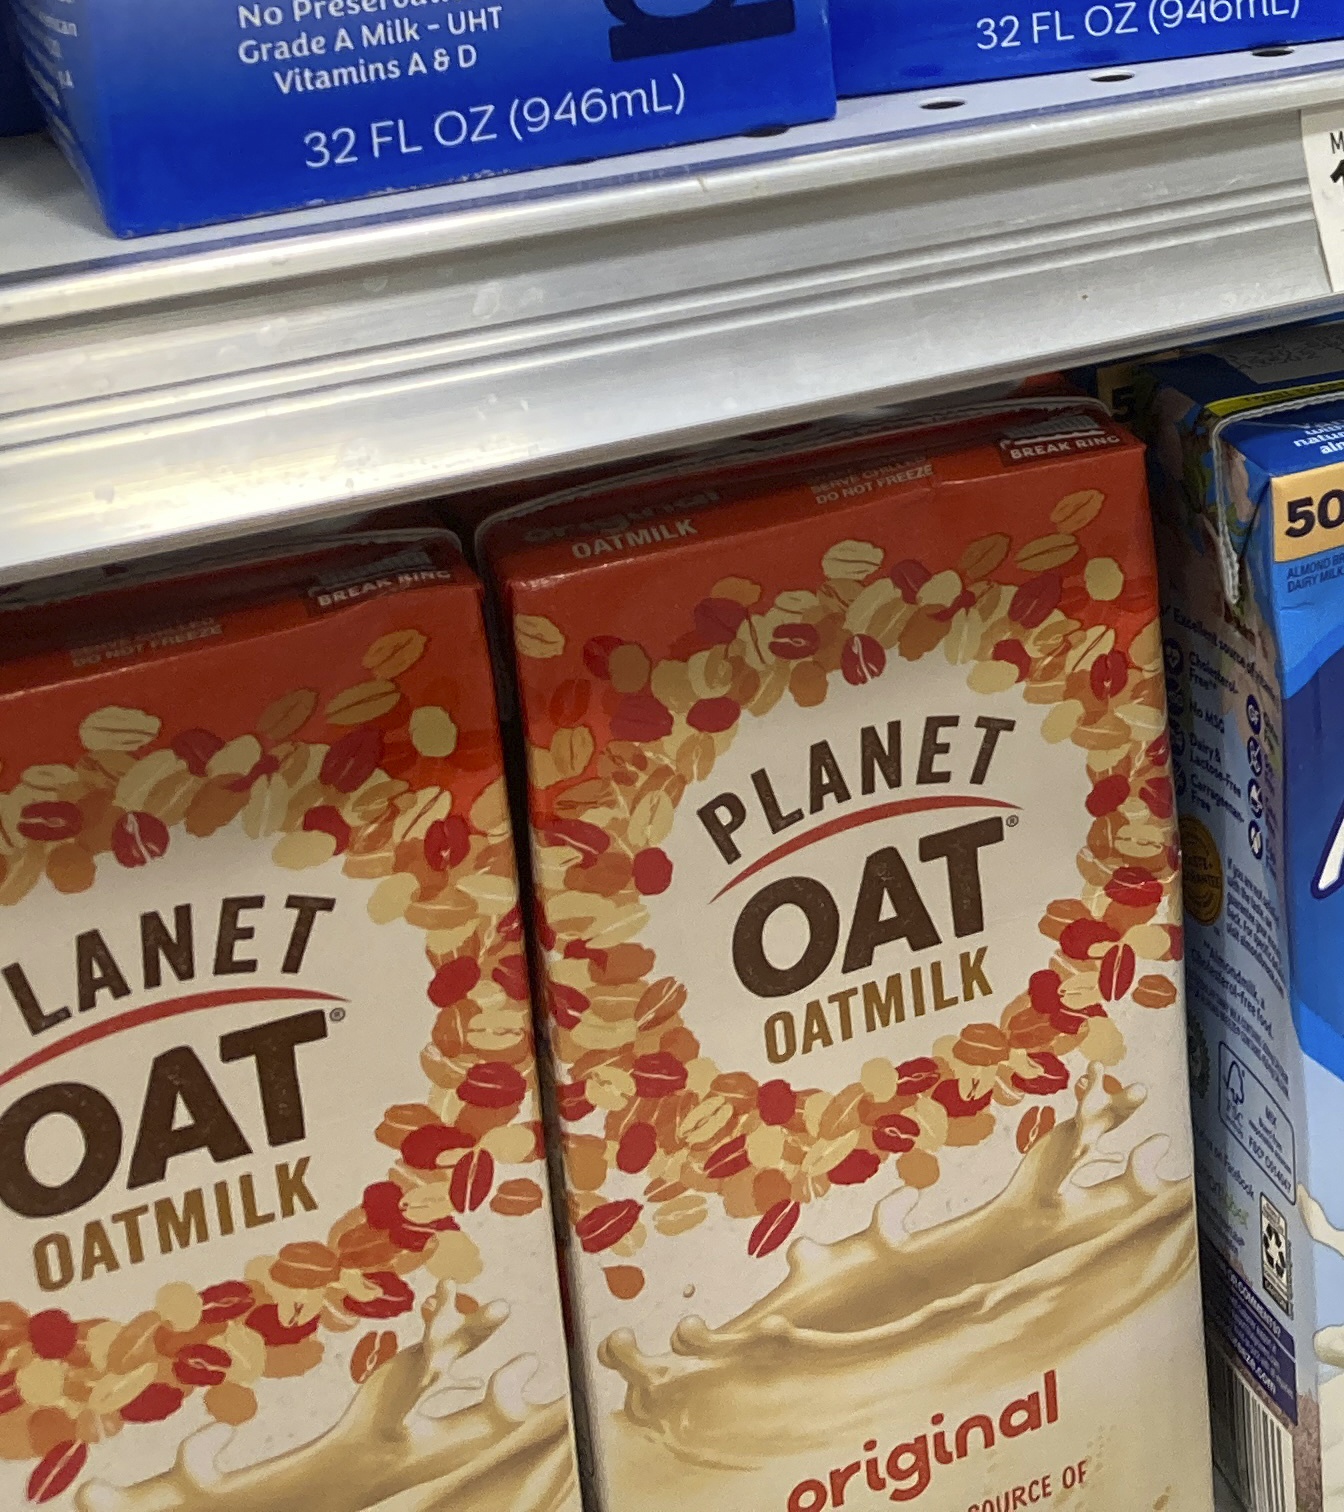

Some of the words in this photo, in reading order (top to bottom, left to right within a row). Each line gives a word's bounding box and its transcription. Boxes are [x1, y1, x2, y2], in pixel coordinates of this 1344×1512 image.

[303, 128, 358, 169] 32
[369, 118, 422, 158] FL
[433, 104, 498, 147] OZ
[508, 73, 687, 143] (946mL)
[571, 518, 698, 561] OATMILK
[695, 714, 1017, 865] PLANET
[731, 815, 1005, 999] OAT
[762, 946, 994, 1065] OATMILK
[33, 1156, 319, 1292] OATMILK
[786, 1369, 1060, 1512] original
